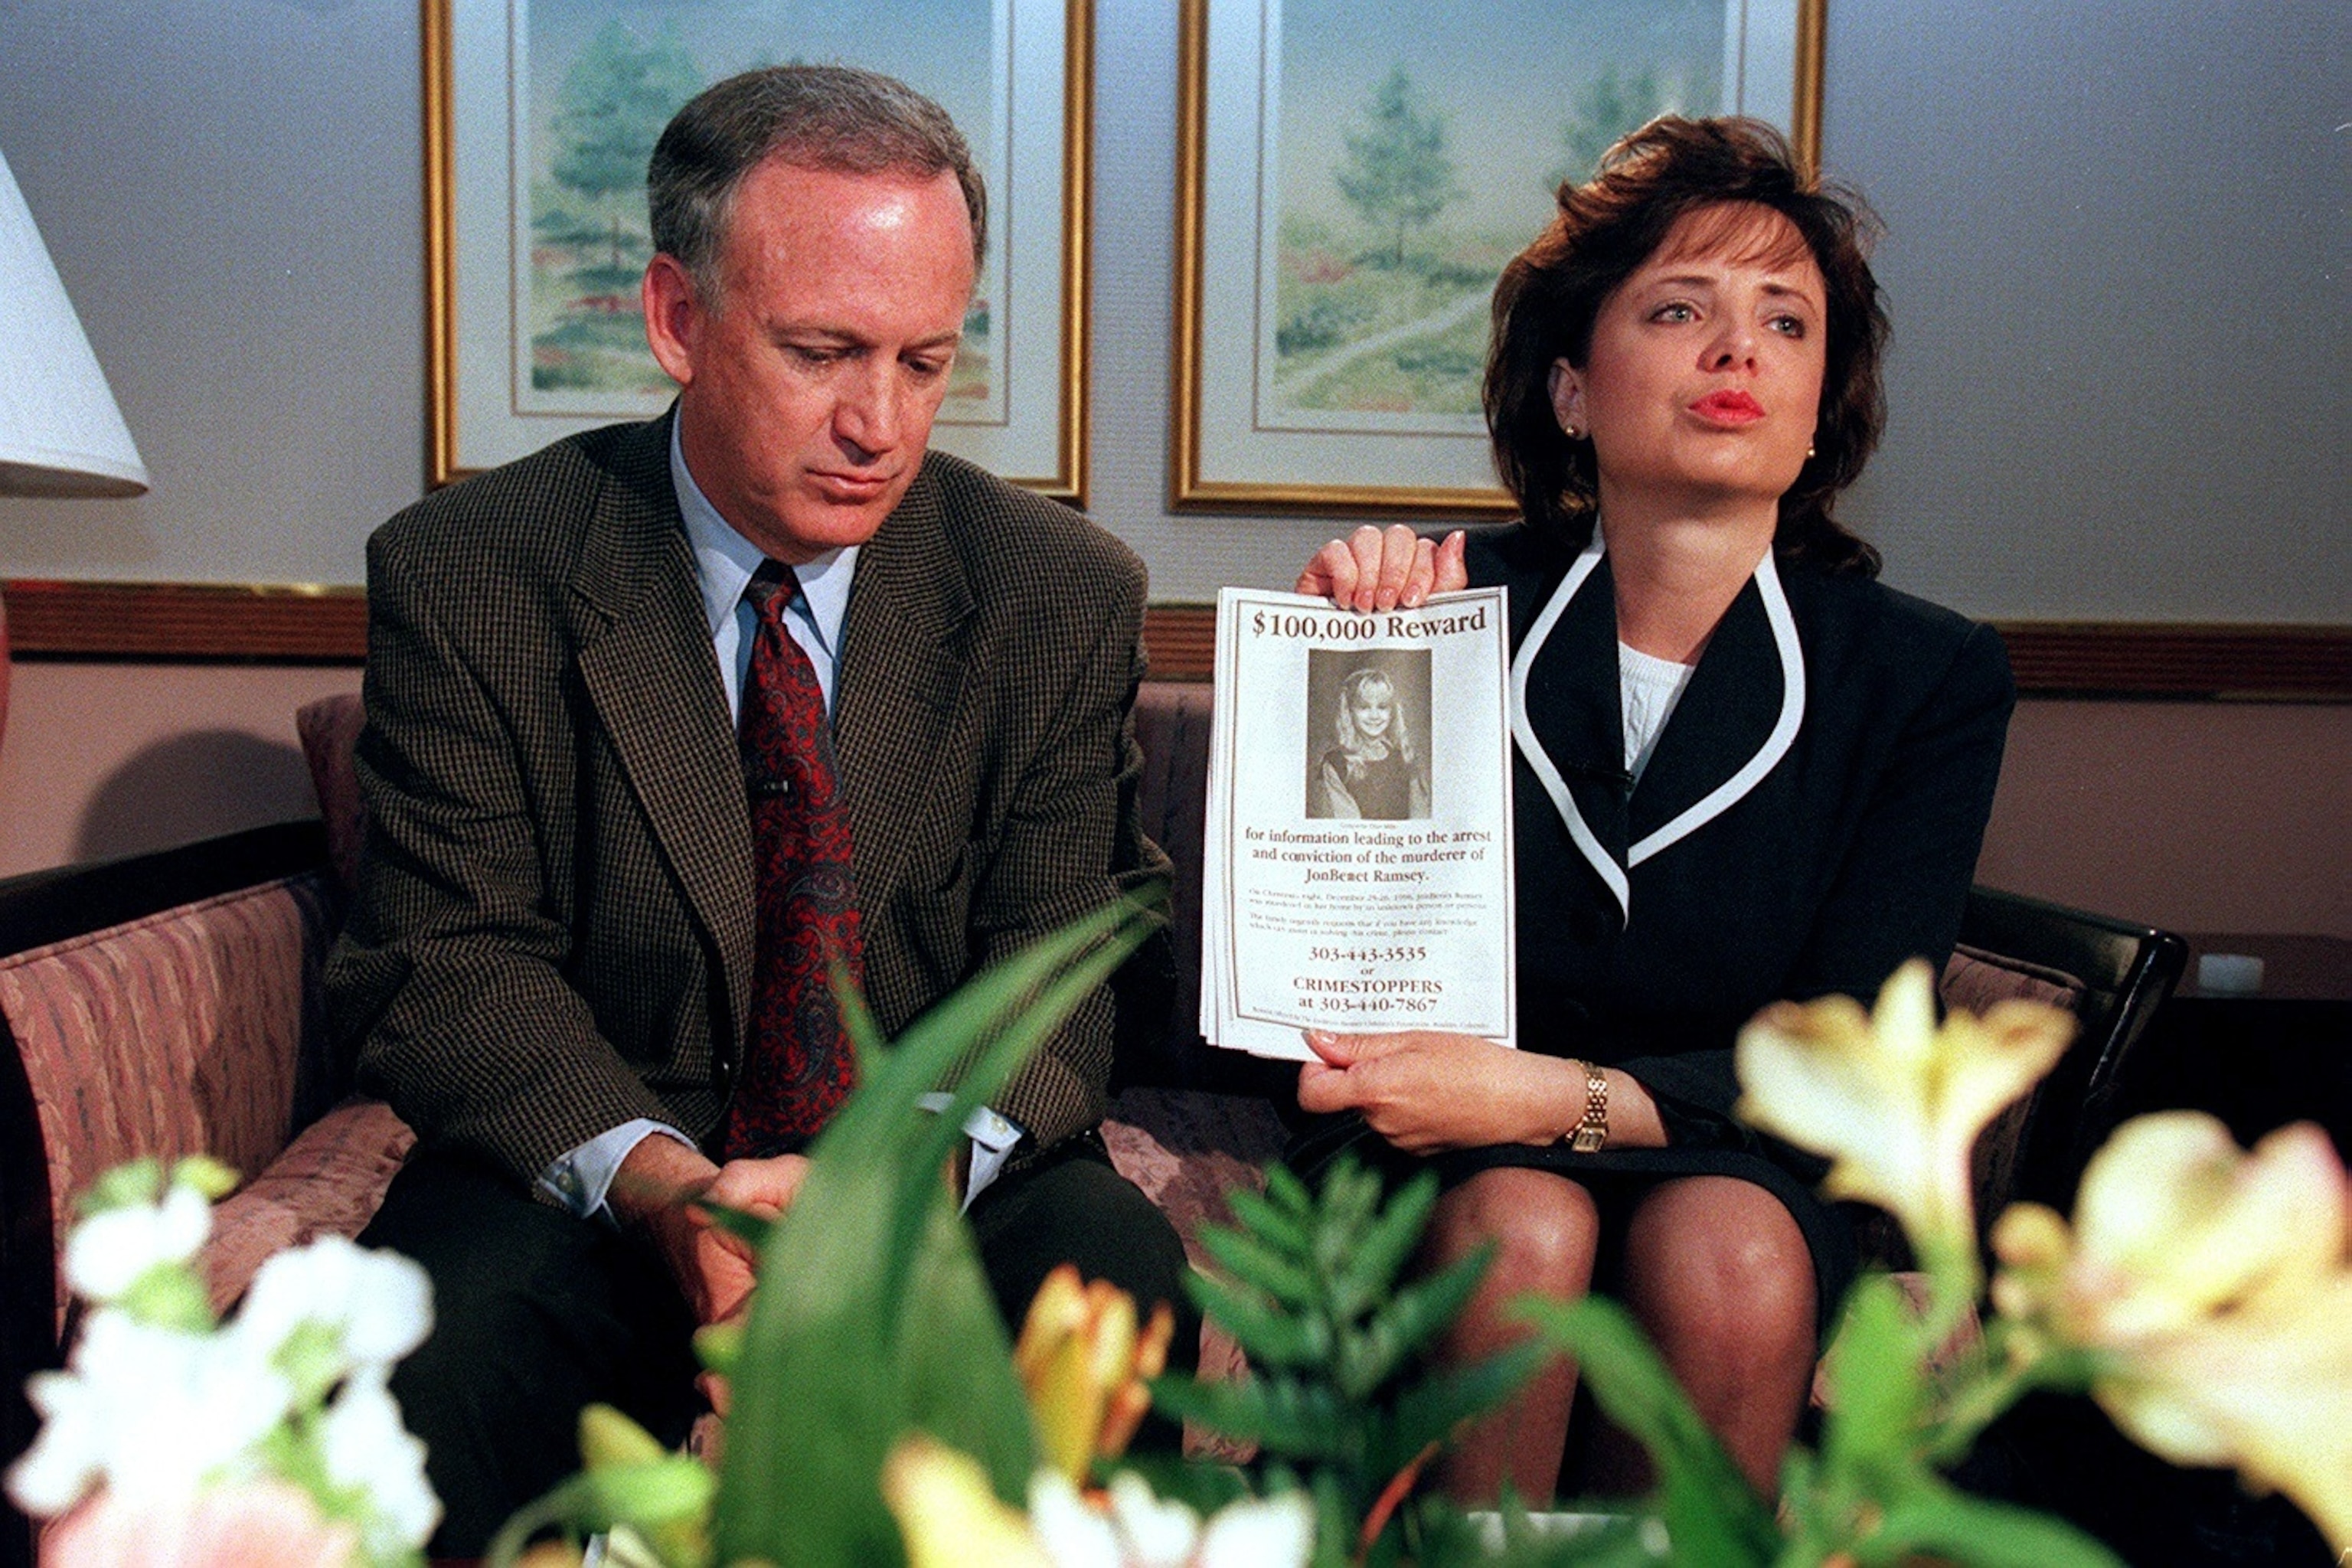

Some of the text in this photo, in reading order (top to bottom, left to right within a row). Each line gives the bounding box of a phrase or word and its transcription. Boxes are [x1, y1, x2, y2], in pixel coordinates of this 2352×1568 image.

[1253, 607, 1487, 641] $100,000 Reward
[1246, 827, 1491, 847] for information leading to the arrest
[1253, 847, 1485, 864] and conviction of the murderer of
[1305, 868, 1429, 884] JonBenet Ramsey.
[1308, 946, 1426, 962] 303-443-3535
[1361, 967, 1374, 975] or
[1293, 977, 1442, 994] CRIMESTOPPERS
[1298, 998, 1437, 1012] at 303-440-7867
